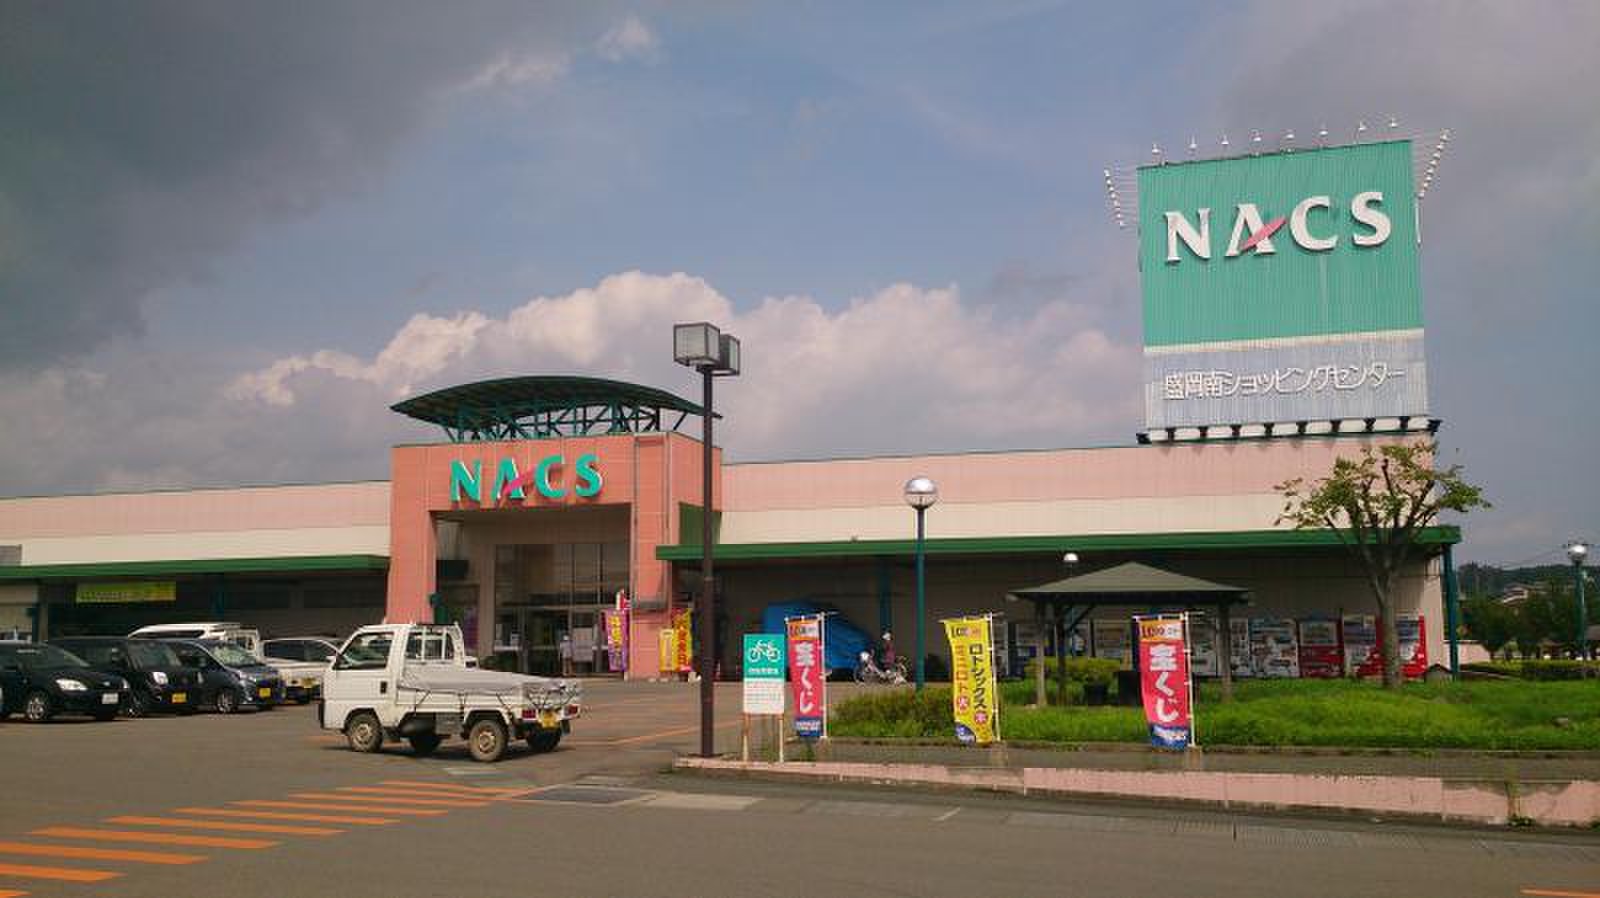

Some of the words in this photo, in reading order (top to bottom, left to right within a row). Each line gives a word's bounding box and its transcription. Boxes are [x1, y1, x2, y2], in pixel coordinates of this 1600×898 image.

[1164, 191, 1392, 262] NACS
[1166, 361, 1406, 399] 盛岡南ショッピングセンター
[449, 453, 603, 501] NACS
[795, 641, 815, 714] 宝くじ
[1149, 644, 1178, 722] 宝くじ
